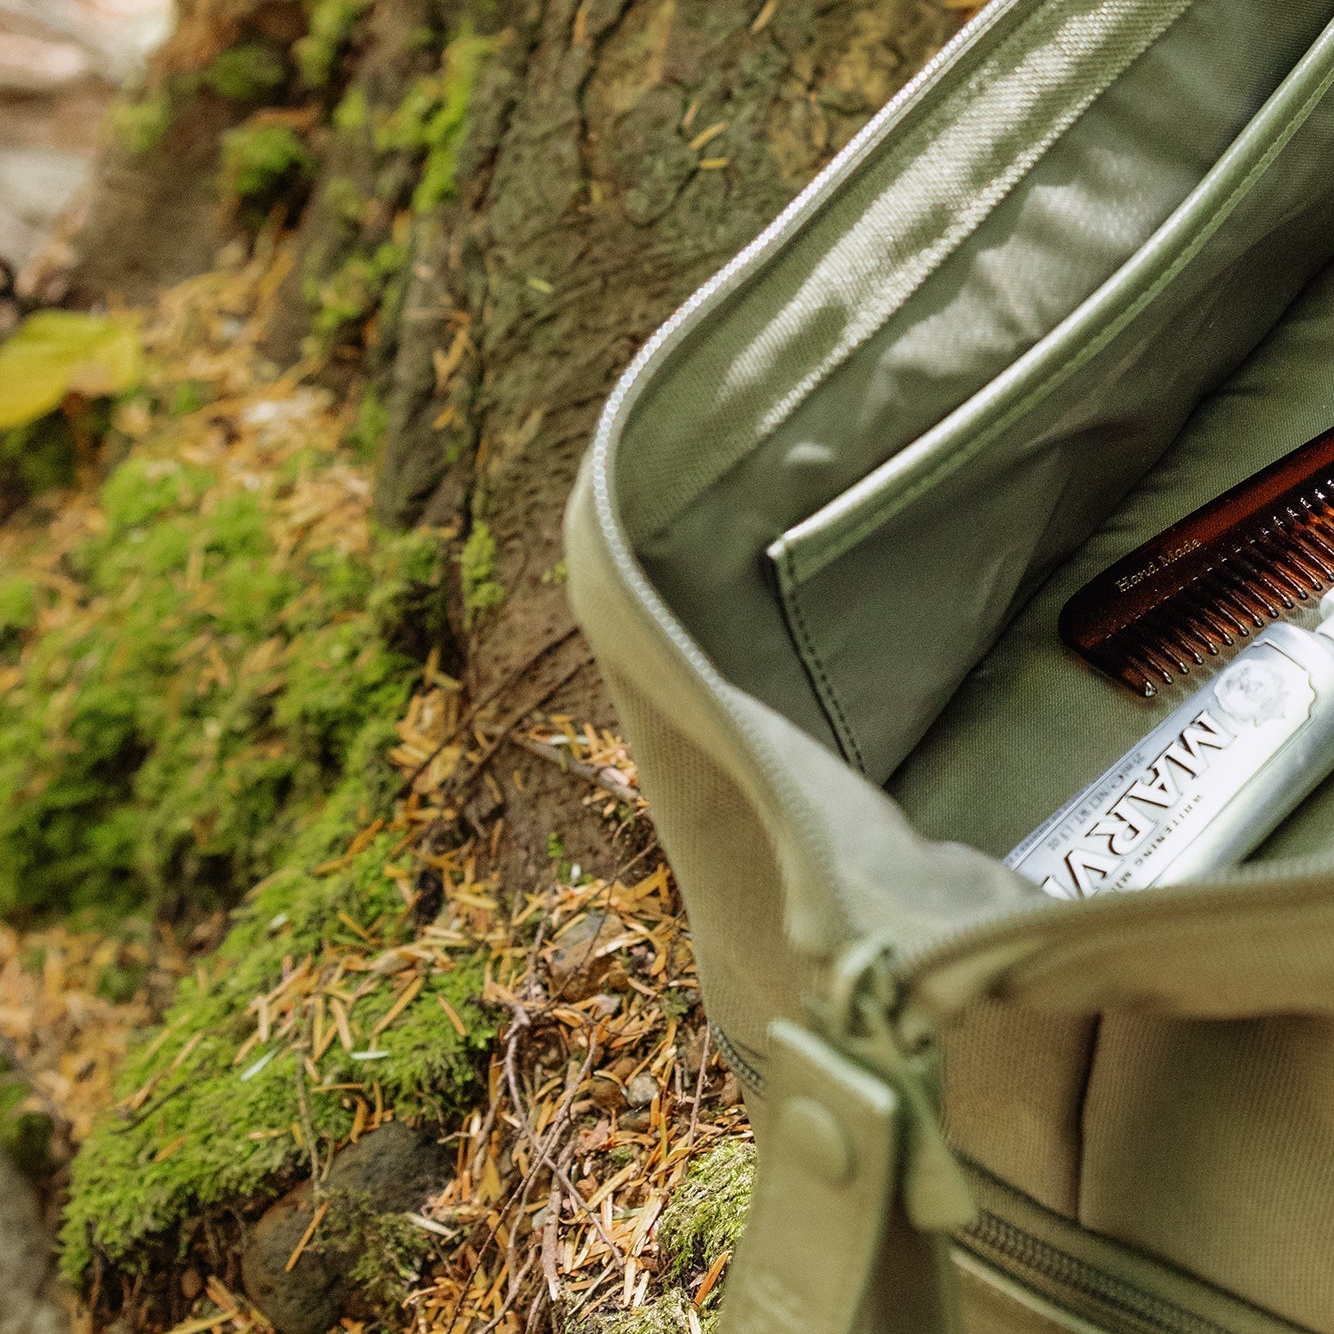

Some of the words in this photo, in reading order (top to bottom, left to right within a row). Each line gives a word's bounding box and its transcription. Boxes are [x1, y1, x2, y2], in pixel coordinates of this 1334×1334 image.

[1114, 560, 1160, 593] Hand
[1157, 537, 1201, 567] Made
[1041, 709, 1238, 898] MARV
[1135, 794, 1203, 866] WHITENING
